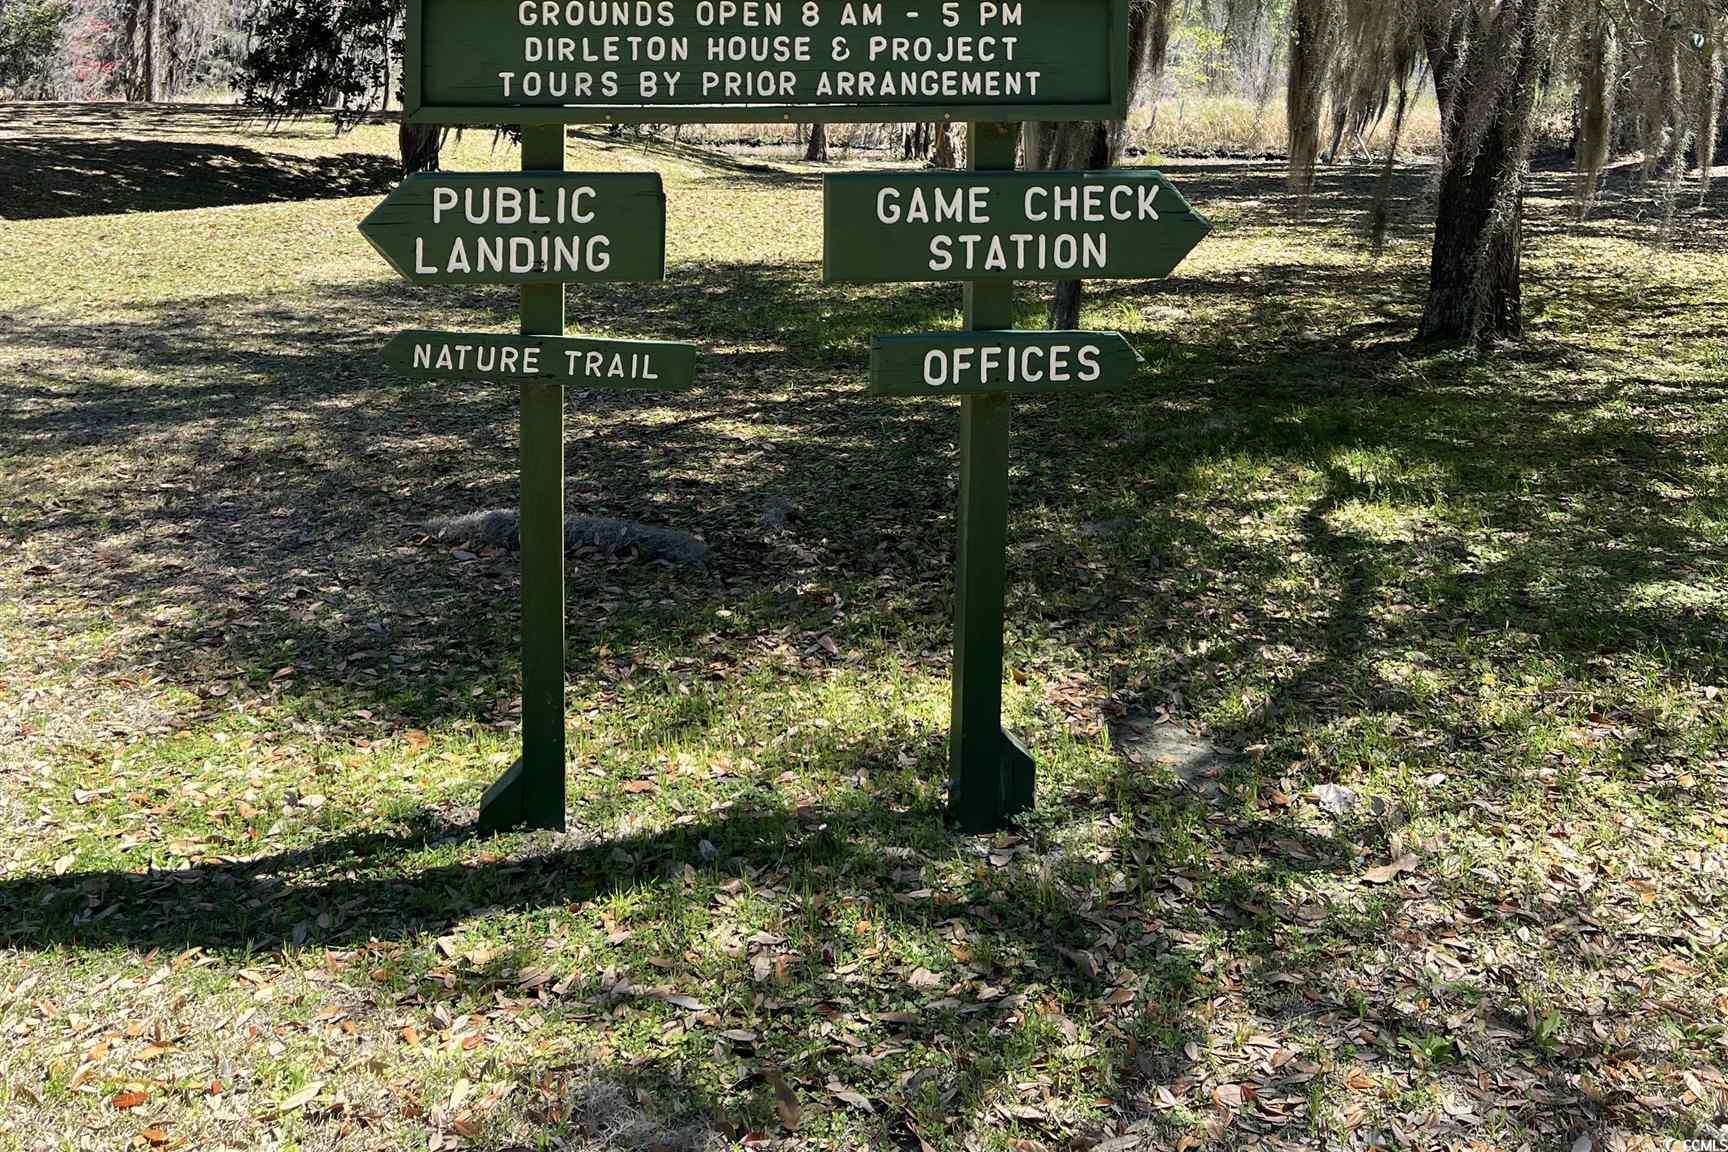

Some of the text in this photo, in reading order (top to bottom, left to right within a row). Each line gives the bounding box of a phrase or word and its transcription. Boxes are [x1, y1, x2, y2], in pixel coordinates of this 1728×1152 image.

[518, 0, 674, 27] GROUNDS
[696, 0, 781, 27] OPEN
[801, 1, 820, 27] 8
[840, 2, 882, 26] AM
[942, 2, 960, 28] 5
[980, 1, 1022, 26] PM
[525, 35, 1017, 62] DIRLETON HOUSE & PROJECT
[498, 70, 1041, 98] TOURS BY PRIOR ARRANGEMENT
[433, 186, 596, 225] PUBLIC
[877, 184, 1160, 224] GAME CHECK
[415, 234, 610, 274] LANDING
[928, 232, 1107, 271] STATION
[413, 343, 658, 379] NATURE TRAIL
[923, 344, 1100, 386] OFFICES
